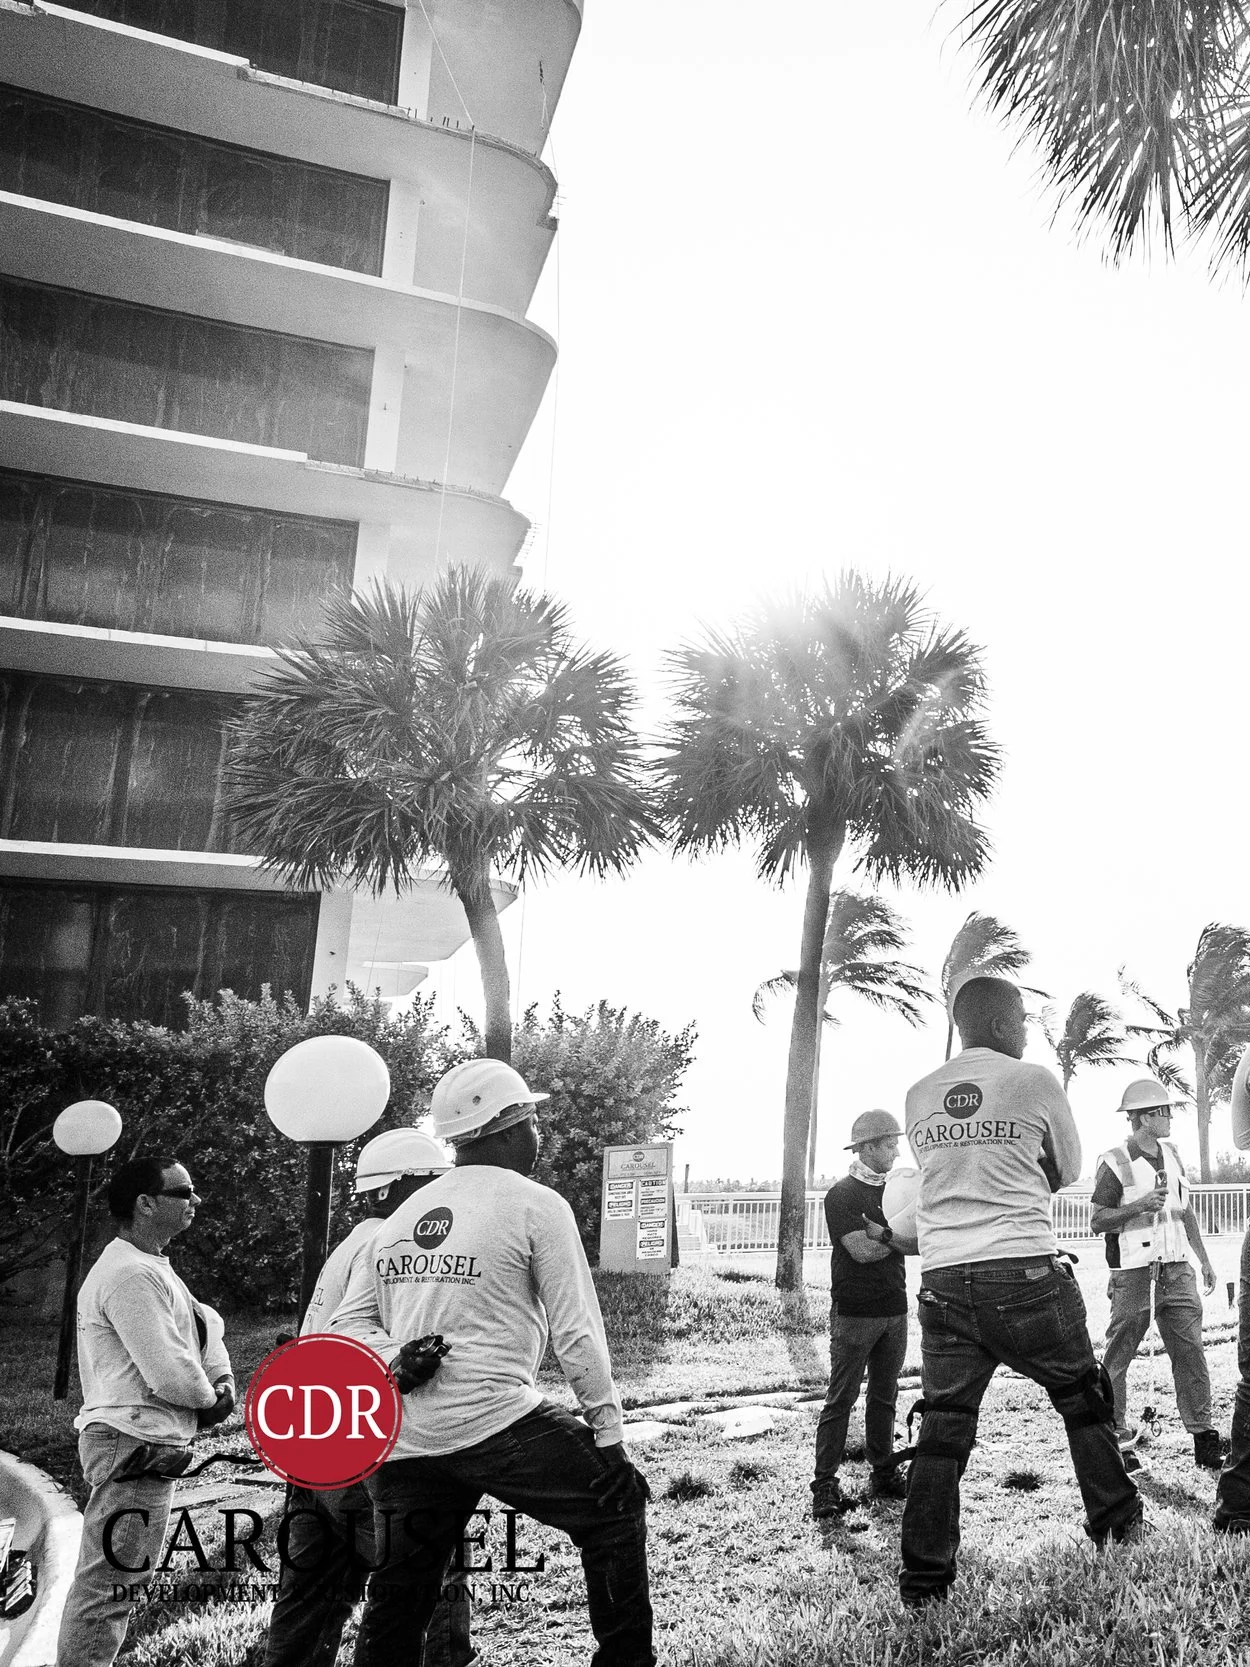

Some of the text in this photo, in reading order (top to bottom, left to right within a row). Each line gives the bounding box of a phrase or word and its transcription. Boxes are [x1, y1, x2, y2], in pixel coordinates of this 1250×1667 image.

[945, 1093, 980, 1109] CDR
[914, 1120, 1022, 1148] CAROUSEL
[416, 1219, 450, 1236] CDR
[376, 1254, 482, 1278] CAROUSEL
